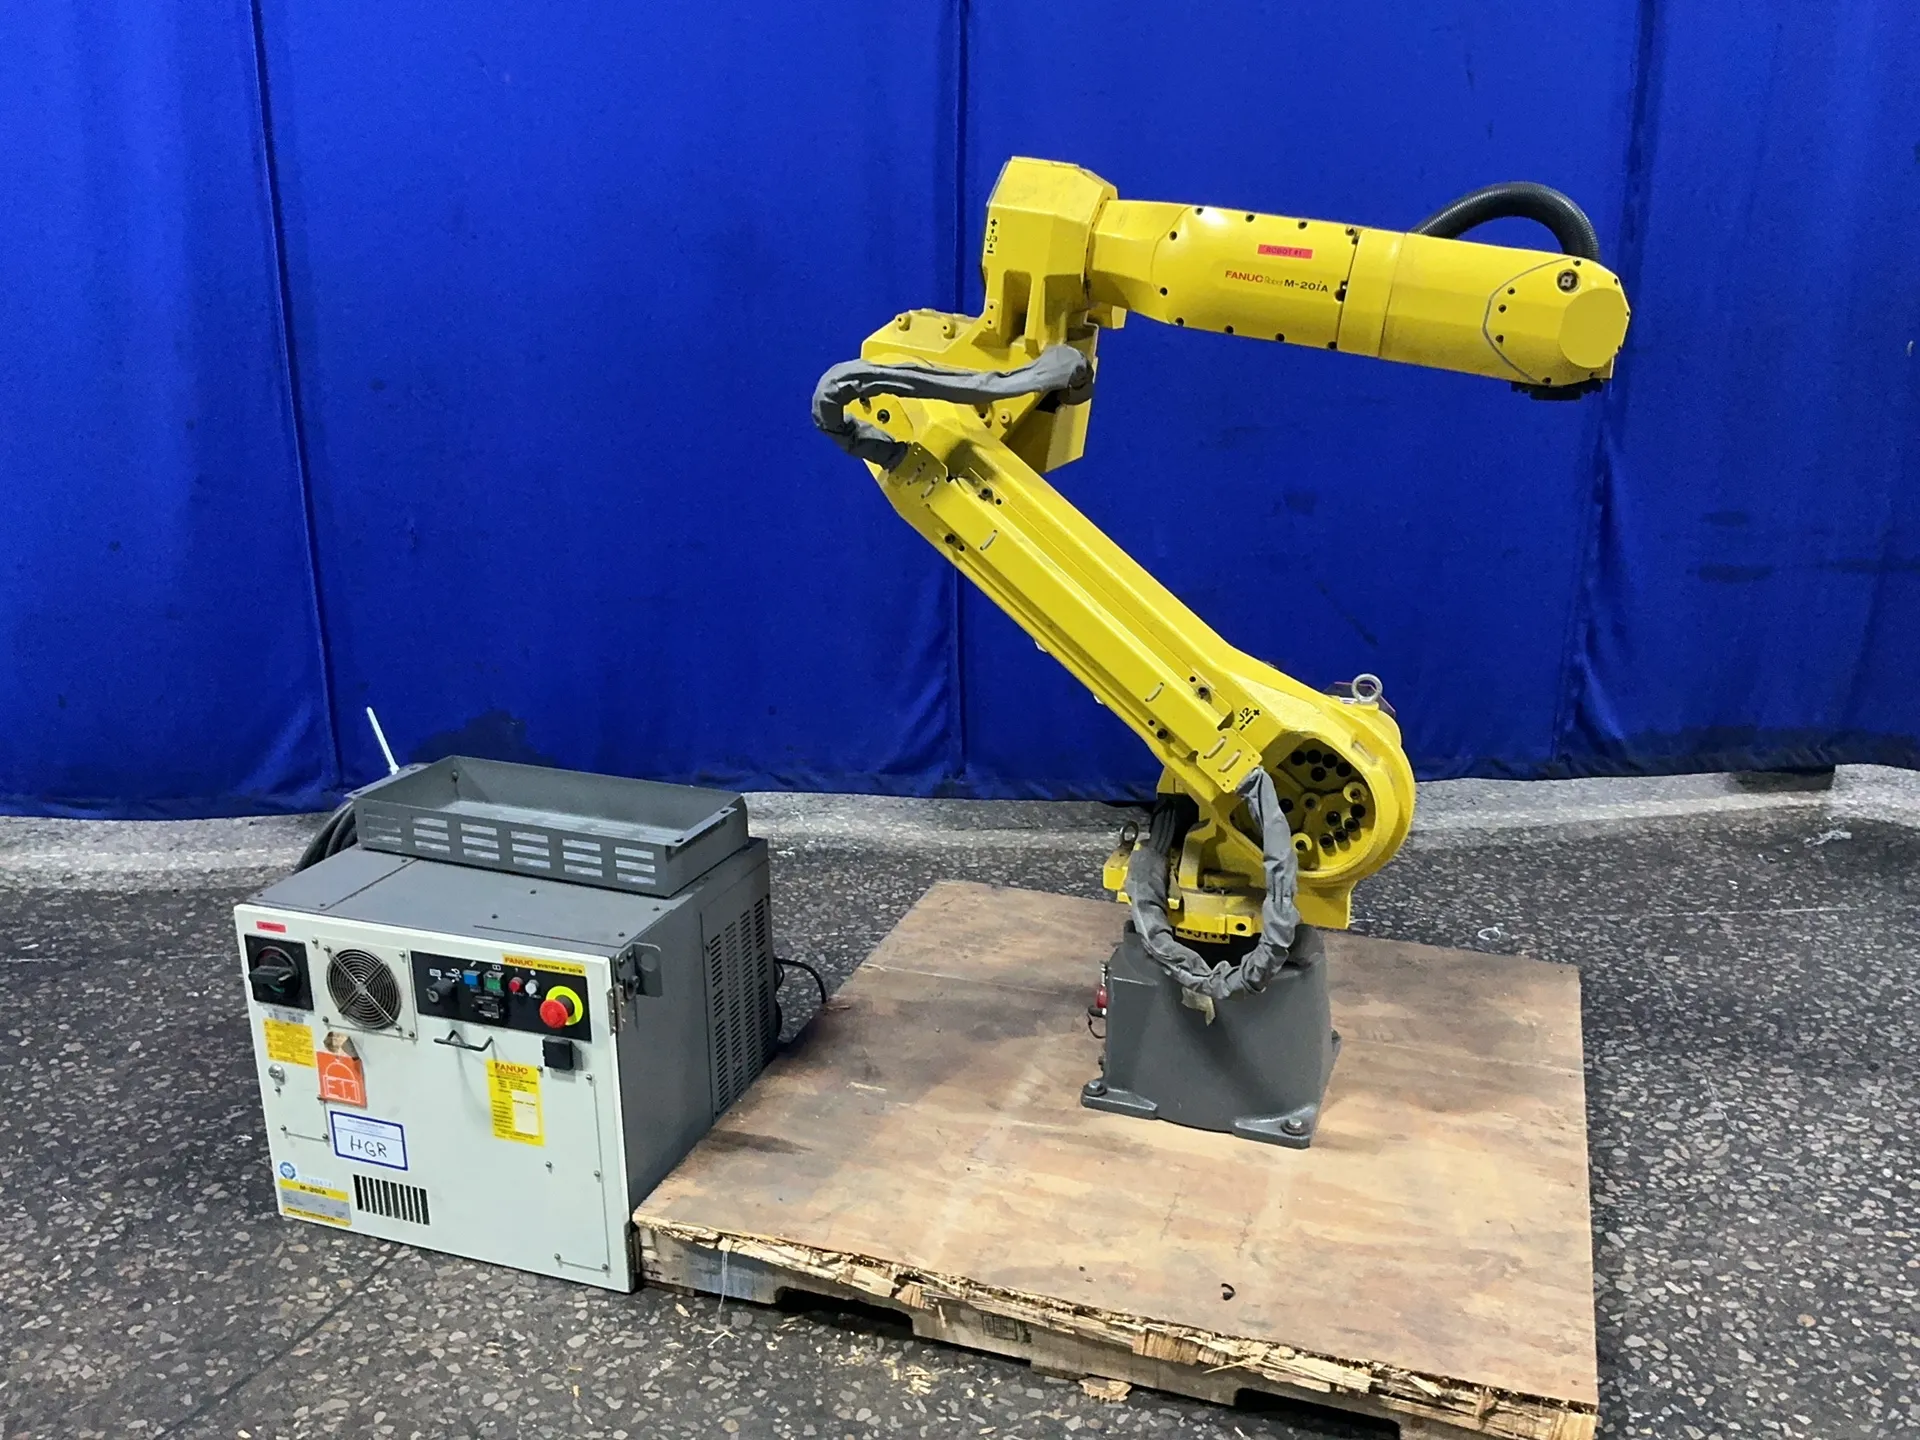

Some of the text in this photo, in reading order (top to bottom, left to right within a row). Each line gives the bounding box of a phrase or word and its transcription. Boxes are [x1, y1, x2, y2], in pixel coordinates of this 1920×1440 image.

[986, 235, 998, 243] J3
[1265, 244, 1292, 256] ROBOT
[1225, 270, 1329, 292] FANUC Robot M-20iA
[1239, 707, 1252, 722] J2
[504, 956, 533, 967] FANUC
[495, 1062, 528, 1075] FANUC
[350, 1135, 387, 1158] HGR
